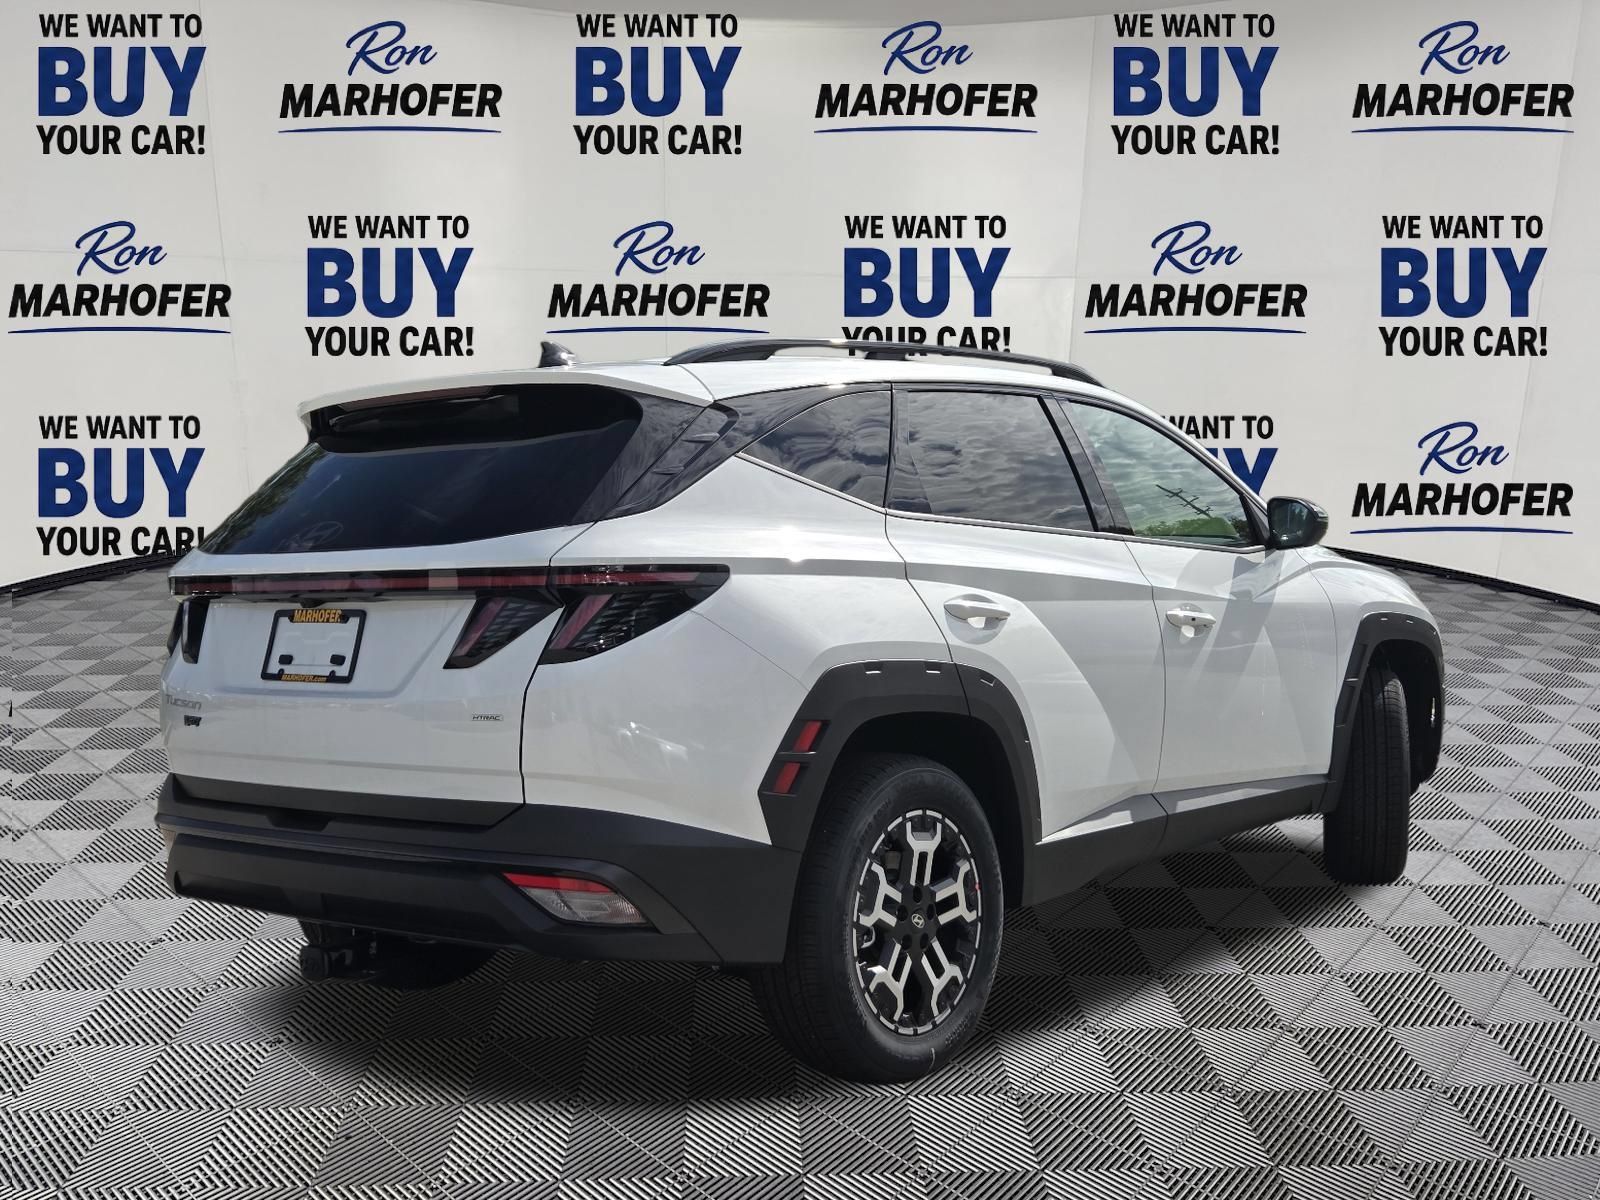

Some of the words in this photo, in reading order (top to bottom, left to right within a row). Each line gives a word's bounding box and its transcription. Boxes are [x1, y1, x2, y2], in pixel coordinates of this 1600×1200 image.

[38, 13, 79, 38] WE
[86, 13, 163, 38] WANT
[169, 13, 203, 39] TO
[575, 13, 616, 38] WE
[623, 13, 699, 38] WANT
[705, 13, 738, 39] TO
[1113, 13, 1154, 38] WE
[1160, 13, 1237, 38] WANT
[1242, 13, 1275, 39] TO
[345, 20, 438, 77] Ron
[881, 20, 974, 76] Ron
[1418, 20, 1511, 76] Ron
[38, 46, 207, 118] BUY
[575, 46, 743, 118] BUY
[1113, 46, 1280, 118] BUY
[279, 82, 503, 119] MARHOFER
[814, 82, 1038, 119] MARHOFER
[1352, 82, 1575, 119] MARHOFER
[35, 124, 122, 156] YOUR
[131, 124, 206, 156] CAR!
[572, 124, 660, 155] YOUR
[667, 124, 742, 155] CAR!
[1110, 124, 1197, 156] YOUR
[1205, 124, 1280, 156] CAR!
[307, 215, 348, 239] WE
[354, 215, 431, 239] WANT
[436, 215, 470, 239] TO
[844, 215, 884, 239] WE
[891, 215, 968, 239] WANT
[974, 215, 1007, 239] TO
[1381, 215, 1421, 239] WE
[1429, 215, 1505, 239] WANT
[1510, 215, 1544, 239] TO
[74, 220, 168, 277] Ron
[613, 220, 706, 277] Ron
[1150, 220, 1243, 277] Ron
[8, 283, 232, 318] MARHOFER
[307, 247, 474, 319] BUY
[547, 283, 771, 319] MARHOFER
[843, 247, 1012, 319] BUY
[1084, 283, 1308, 318] MARHOFER
[1380, 247, 1548, 319] BUY
[304, 325, 391, 357] YOUR
[399, 325, 474, 357] CAR!
[936, 325, 1011, 353] CAR!
[1377, 325, 1465, 357] YOUR
[1473, 325, 1548, 357] CAR!
[38, 415, 78, 440] WE
[85, 415, 162, 440] WANT
[168, 415, 201, 440] TO
[1242, 415, 1275, 440] TO
[1417, 421, 1510, 476] Ron
[38, 447, 206, 519] BUY
[1351, 482, 1574, 518] MARHOFER
[35, 526, 122, 557] YOUR
[293, 608, 343, 623] MARHOFER
